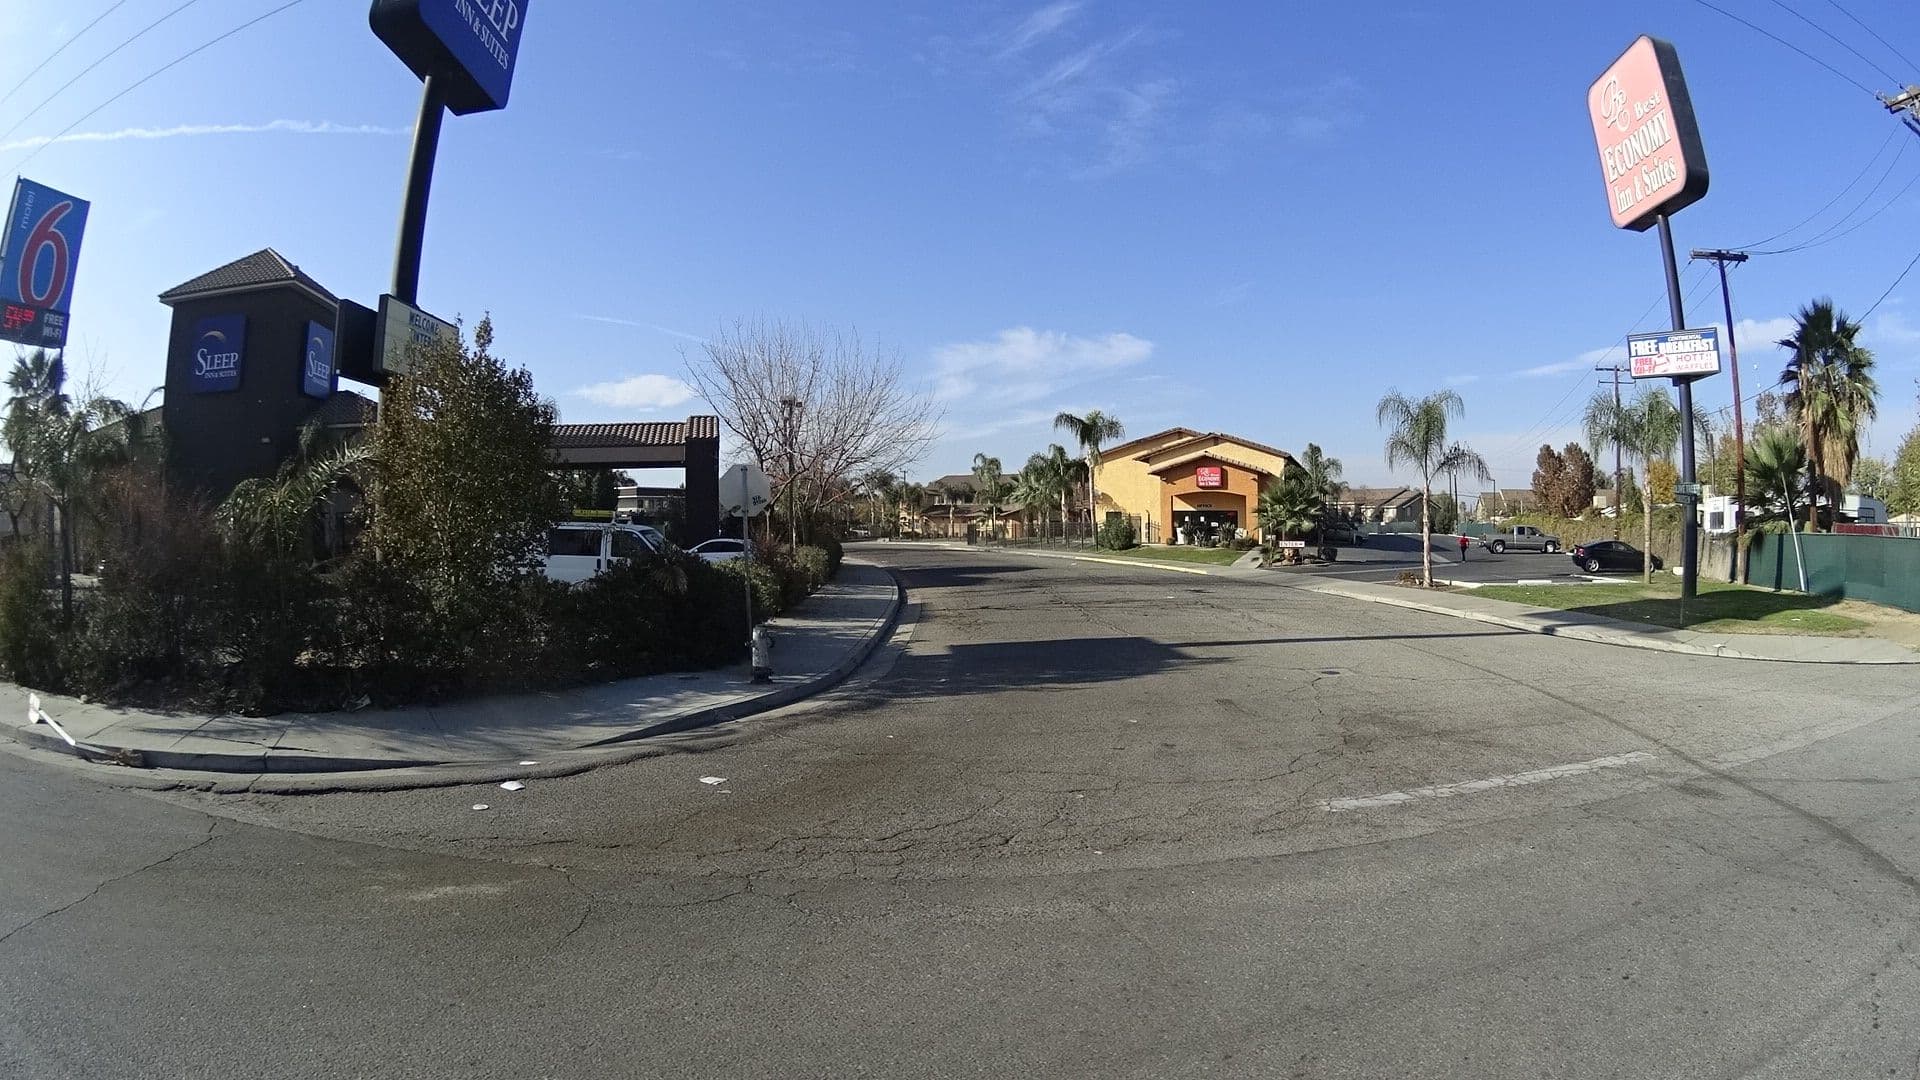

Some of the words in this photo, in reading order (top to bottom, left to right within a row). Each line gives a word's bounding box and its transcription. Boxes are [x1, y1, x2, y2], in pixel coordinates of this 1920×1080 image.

[480, 25, 509, 69] SUITES
[1603, 109, 1672, 184] ECONOMY
[1613, 184, 1634, 214] Inn
[1641, 155, 1678, 197] Suites
[18, 201, 73, 310] 6
[44, 313, 65, 326] FREE
[196, 348, 239, 376] SLEEP
[1630, 340, 1658, 356] FREE
[1658, 338, 1715, 354] BREAKFAST
[1634, 358, 1653, 366] FREE
